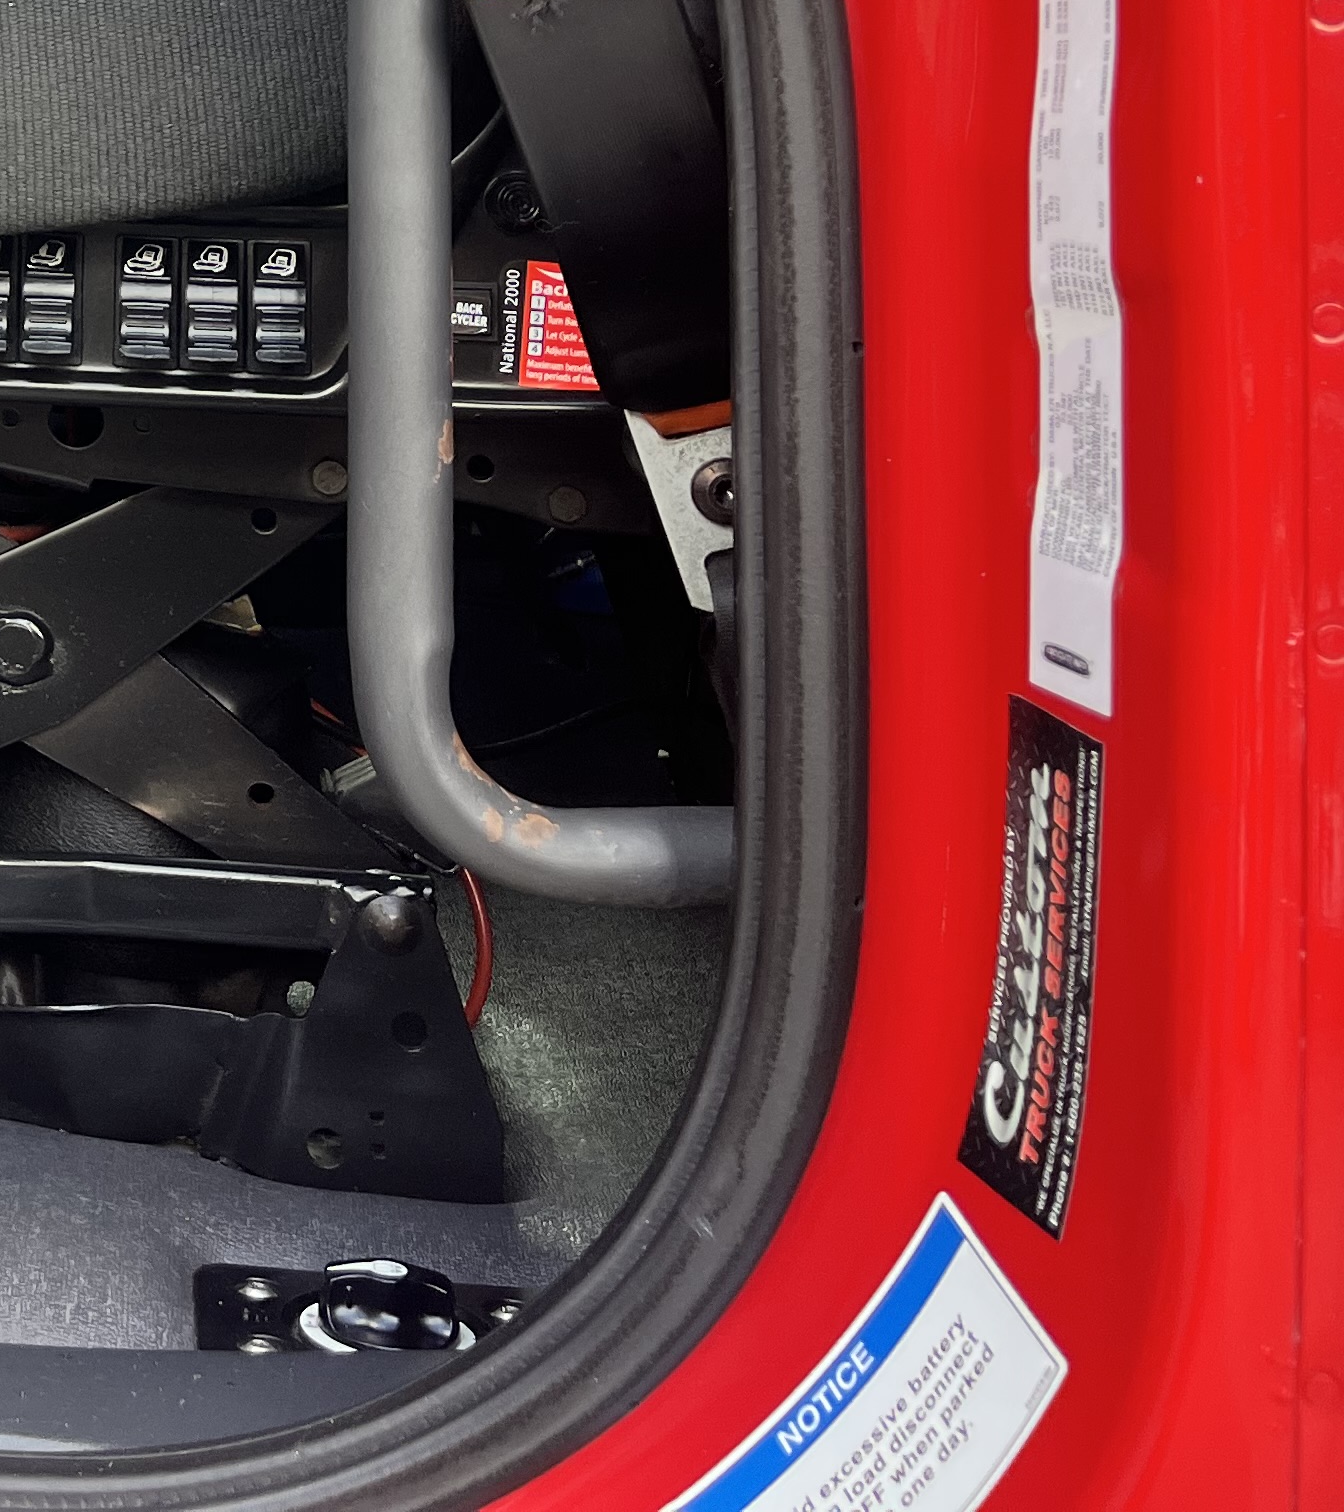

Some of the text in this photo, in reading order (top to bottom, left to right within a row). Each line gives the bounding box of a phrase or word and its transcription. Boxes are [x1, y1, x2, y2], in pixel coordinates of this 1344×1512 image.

[450, 313, 488, 327] CYCLER
[456, 302, 483, 315] BACK
[499, 269, 521, 373] National 2000
[988, 827, 1016, 1043] SERVICES PROVIDED BY
[1019, 769, 1071, 1164] TRUCK SERVICES
[1049, 1171, 1070, 1226] Phone
[776, 1341, 876, 1456] NOTICE
[820, 1314, 968, 1499] excessive battery
[843, 1329, 980, 1503] load disconnect
[890, 1426, 939, 1485] when
[940, 1344, 996, 1429] parked
[901, 1419, 974, 1507] one day.
